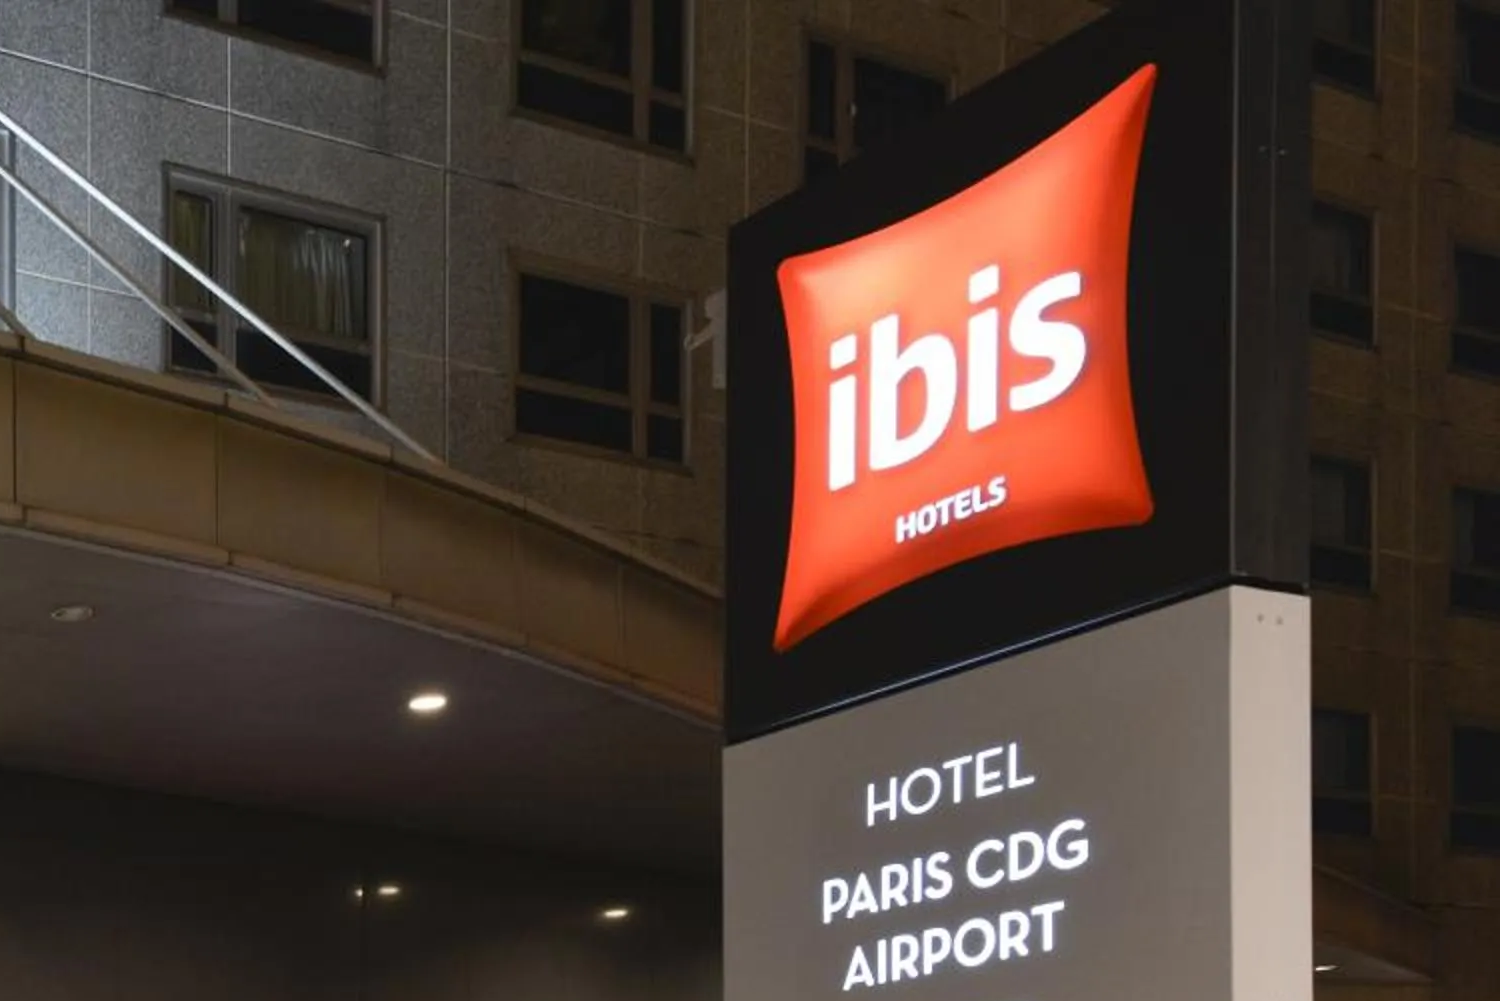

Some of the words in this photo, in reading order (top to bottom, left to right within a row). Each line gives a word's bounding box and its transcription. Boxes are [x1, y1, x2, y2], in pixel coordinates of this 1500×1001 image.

[827, 263, 1088, 492] ibis
[895, 475, 1007, 543] HOTELS
[866, 742, 1036, 827] HOTEL
[821, 851, 954, 925] PARIS
[965, 818, 1090, 889] CDG
[842, 899, 1066, 992] AIRPORT
